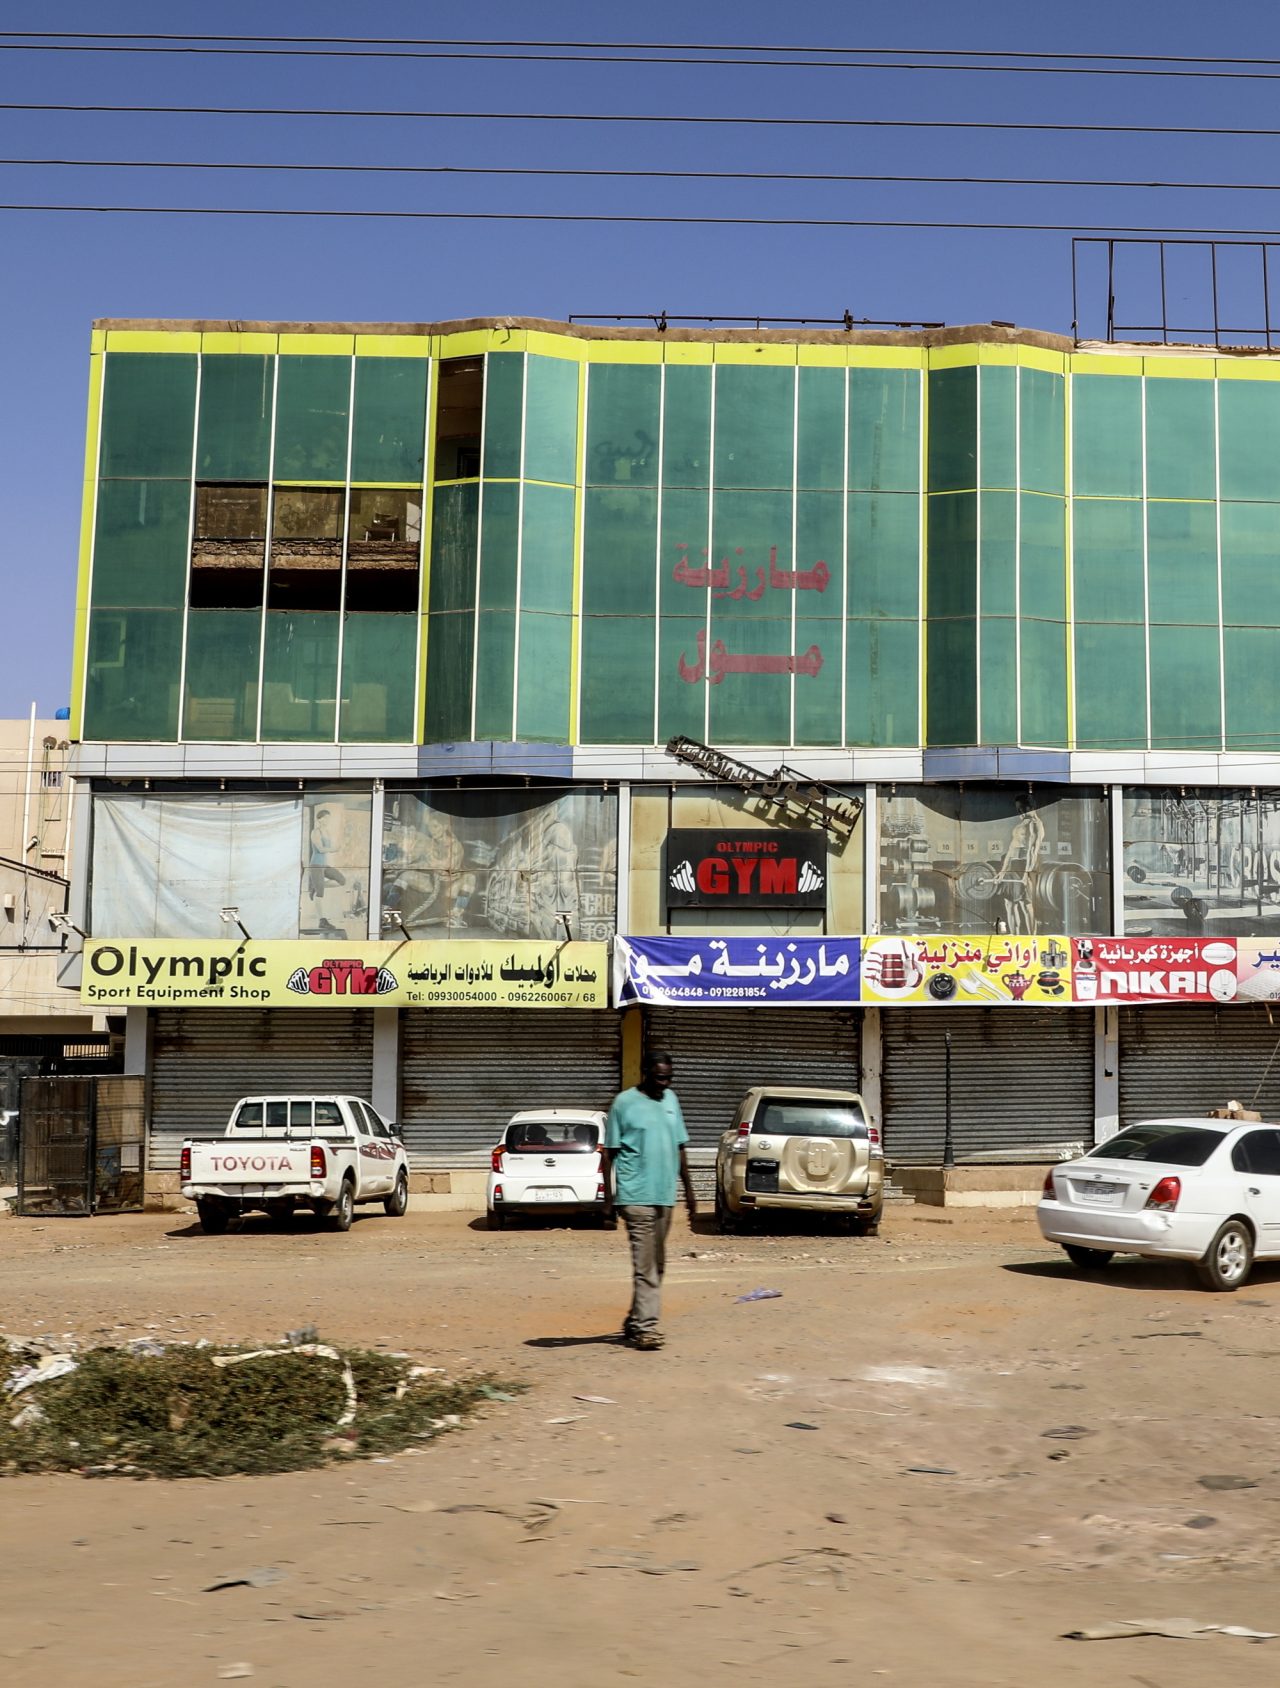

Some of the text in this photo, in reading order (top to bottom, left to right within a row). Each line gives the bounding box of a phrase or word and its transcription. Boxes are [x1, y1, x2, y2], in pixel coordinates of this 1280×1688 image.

[673, 543, 831, 601] مارزينة
[678, 629, 824, 684] مول
[716, 842, 779, 852] OLYMPIC
[696, 857, 797, 894] GYM
[90, 946, 267, 984] Olympic
[630, 939, 849, 990] مارزينة مو
[916, 939, 1038, 973] أواني منزلية
[1098, 942, 1199, 965] أجهزة كهربائية
[309, 967, 378, 994] GYM
[407, 962, 451, 986] الرياضية
[564, 965, 597, 983] محلات
[88, 985, 271, 1001] Sport Equipment Shop
[406, 991, 424, 1001] Tel:
[428, 991, 497, 1001] 09930054000
[508, 992, 573, 1002] 0962260067
[583, 993, 596, 1002] 68
[710, 987, 767, 997] 0912281854
[210, 1156, 293, 1171] TOYOTA
